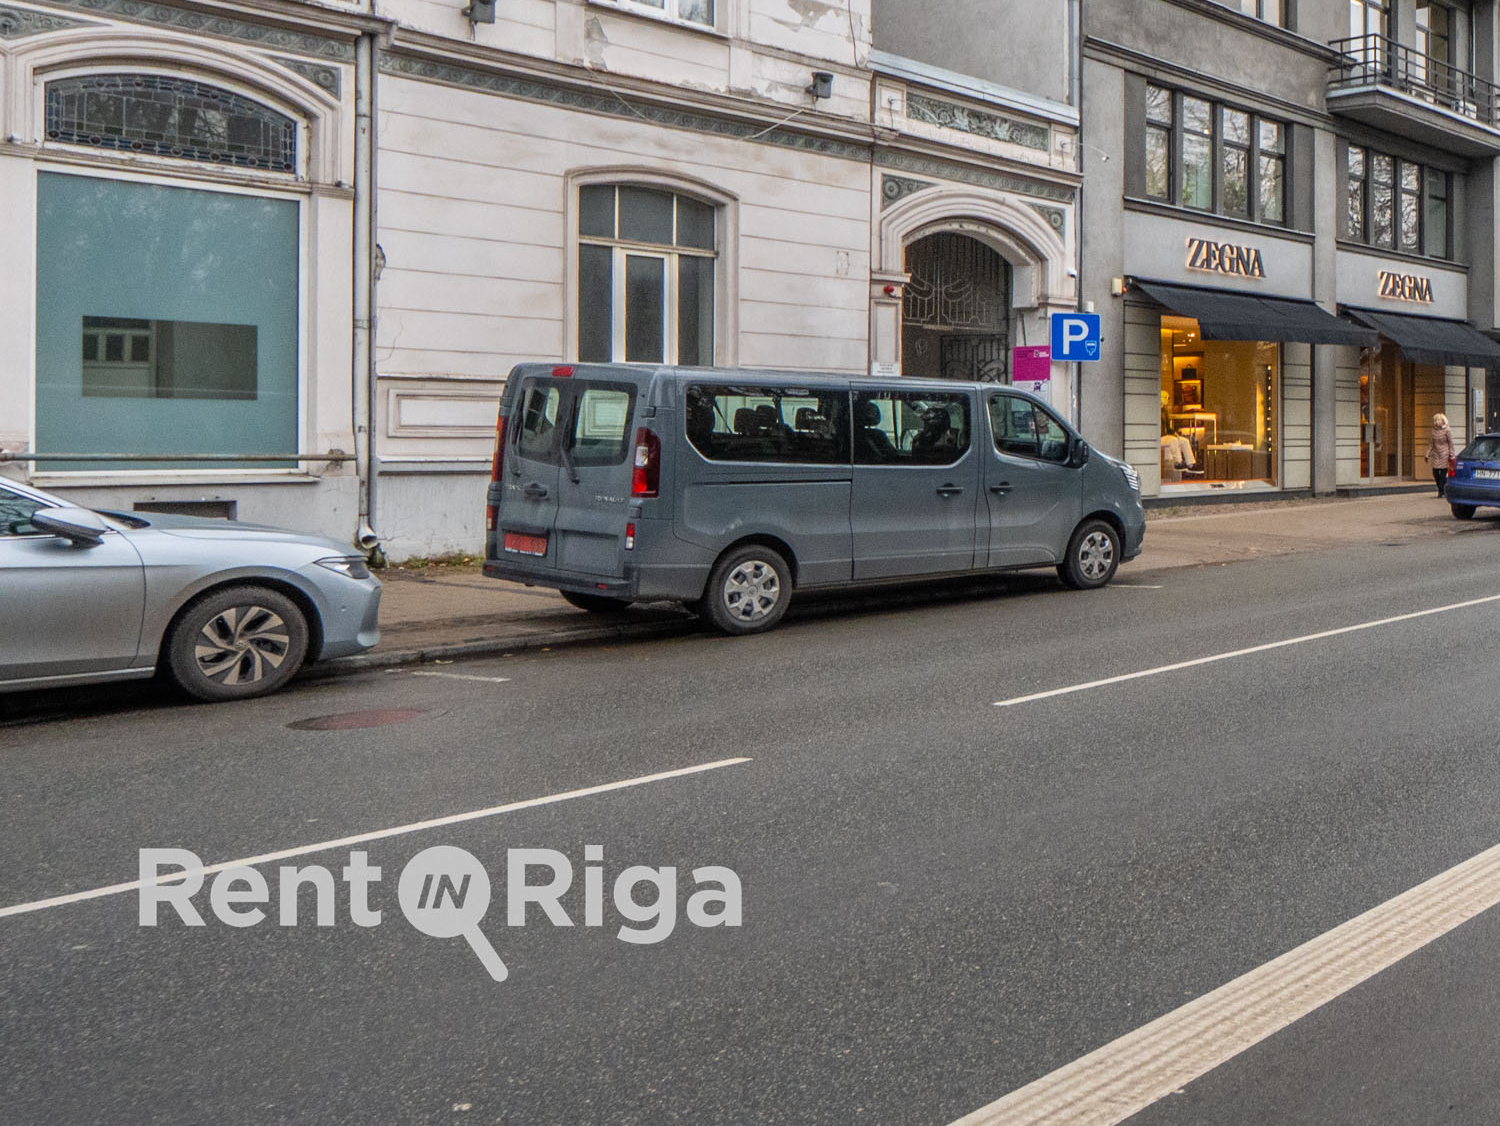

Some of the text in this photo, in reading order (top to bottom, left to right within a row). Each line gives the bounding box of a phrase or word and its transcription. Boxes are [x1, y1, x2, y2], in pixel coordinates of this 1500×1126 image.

[1187, 238, 1266, 278] ZEGNA
[1379, 271, 1435, 302] ZEGNA
[1063, 319, 1089, 354] P
